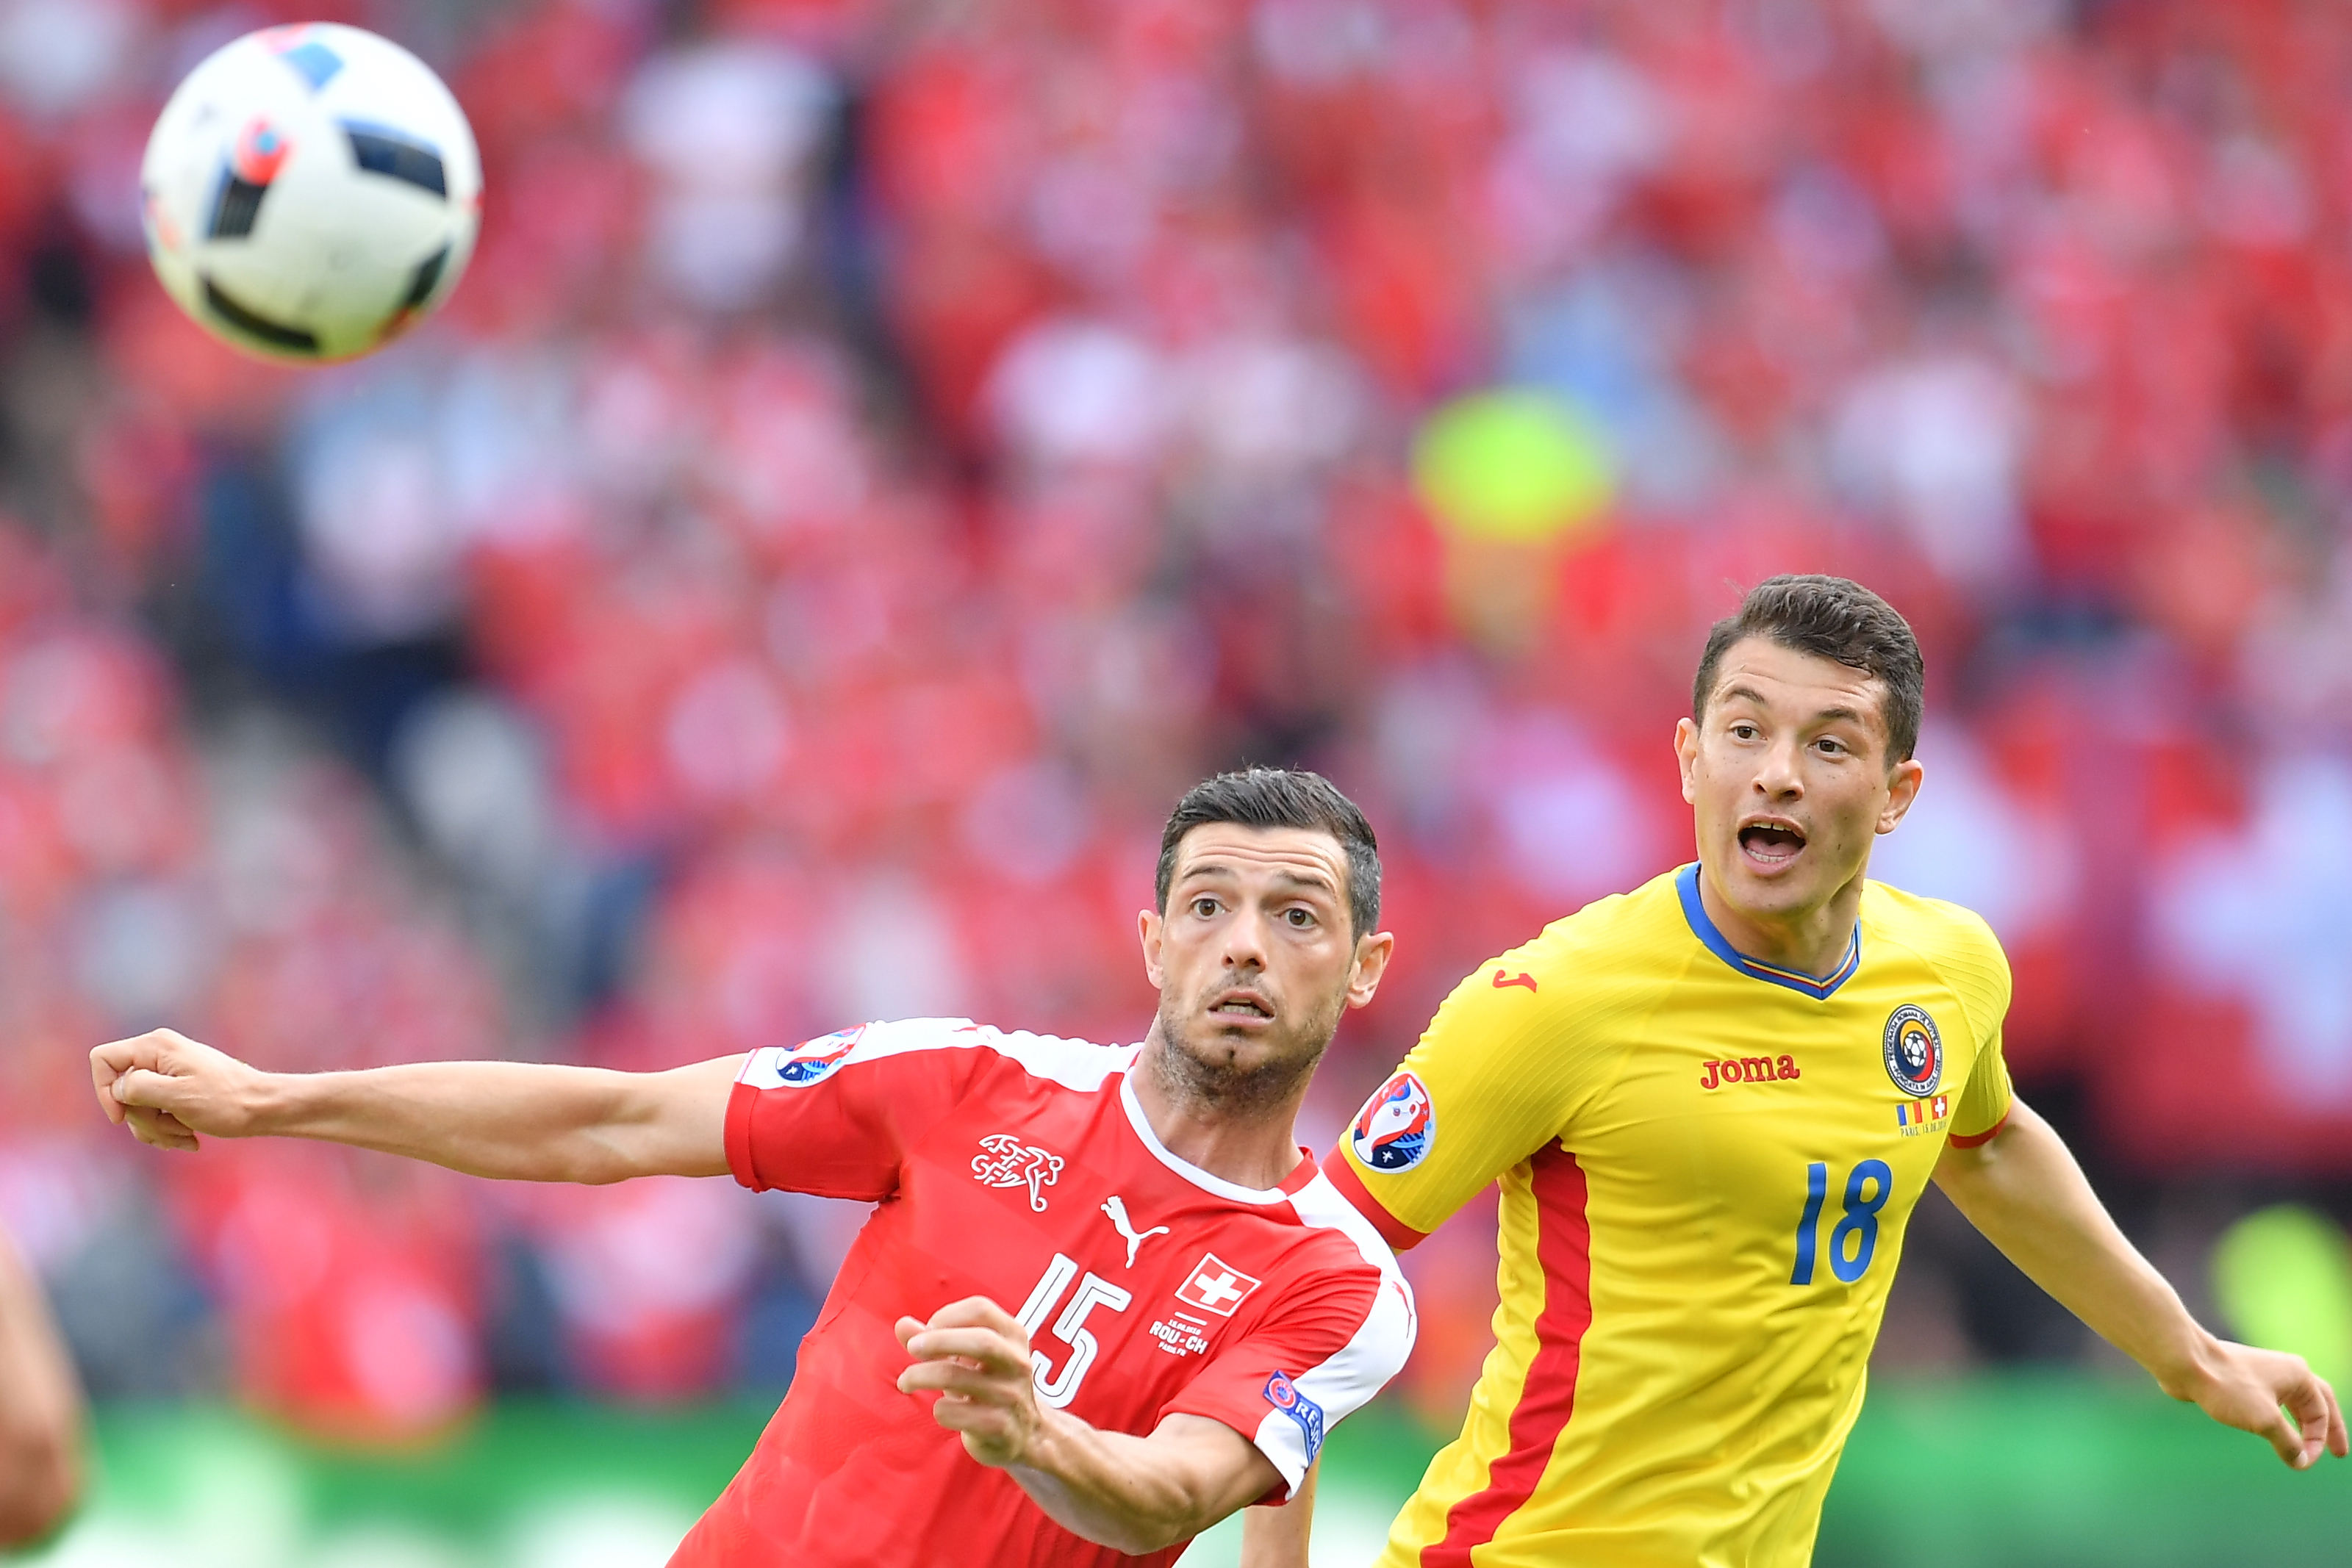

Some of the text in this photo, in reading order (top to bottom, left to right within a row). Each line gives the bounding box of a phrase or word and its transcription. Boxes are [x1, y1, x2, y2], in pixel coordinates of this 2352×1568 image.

[1700, 1054, 1800, 1090] Joma
[1789, 1158, 1893, 1286] 18
[1014, 1252, 1133, 1409] 15
[1294, 1401, 1321, 1456] RESPE
